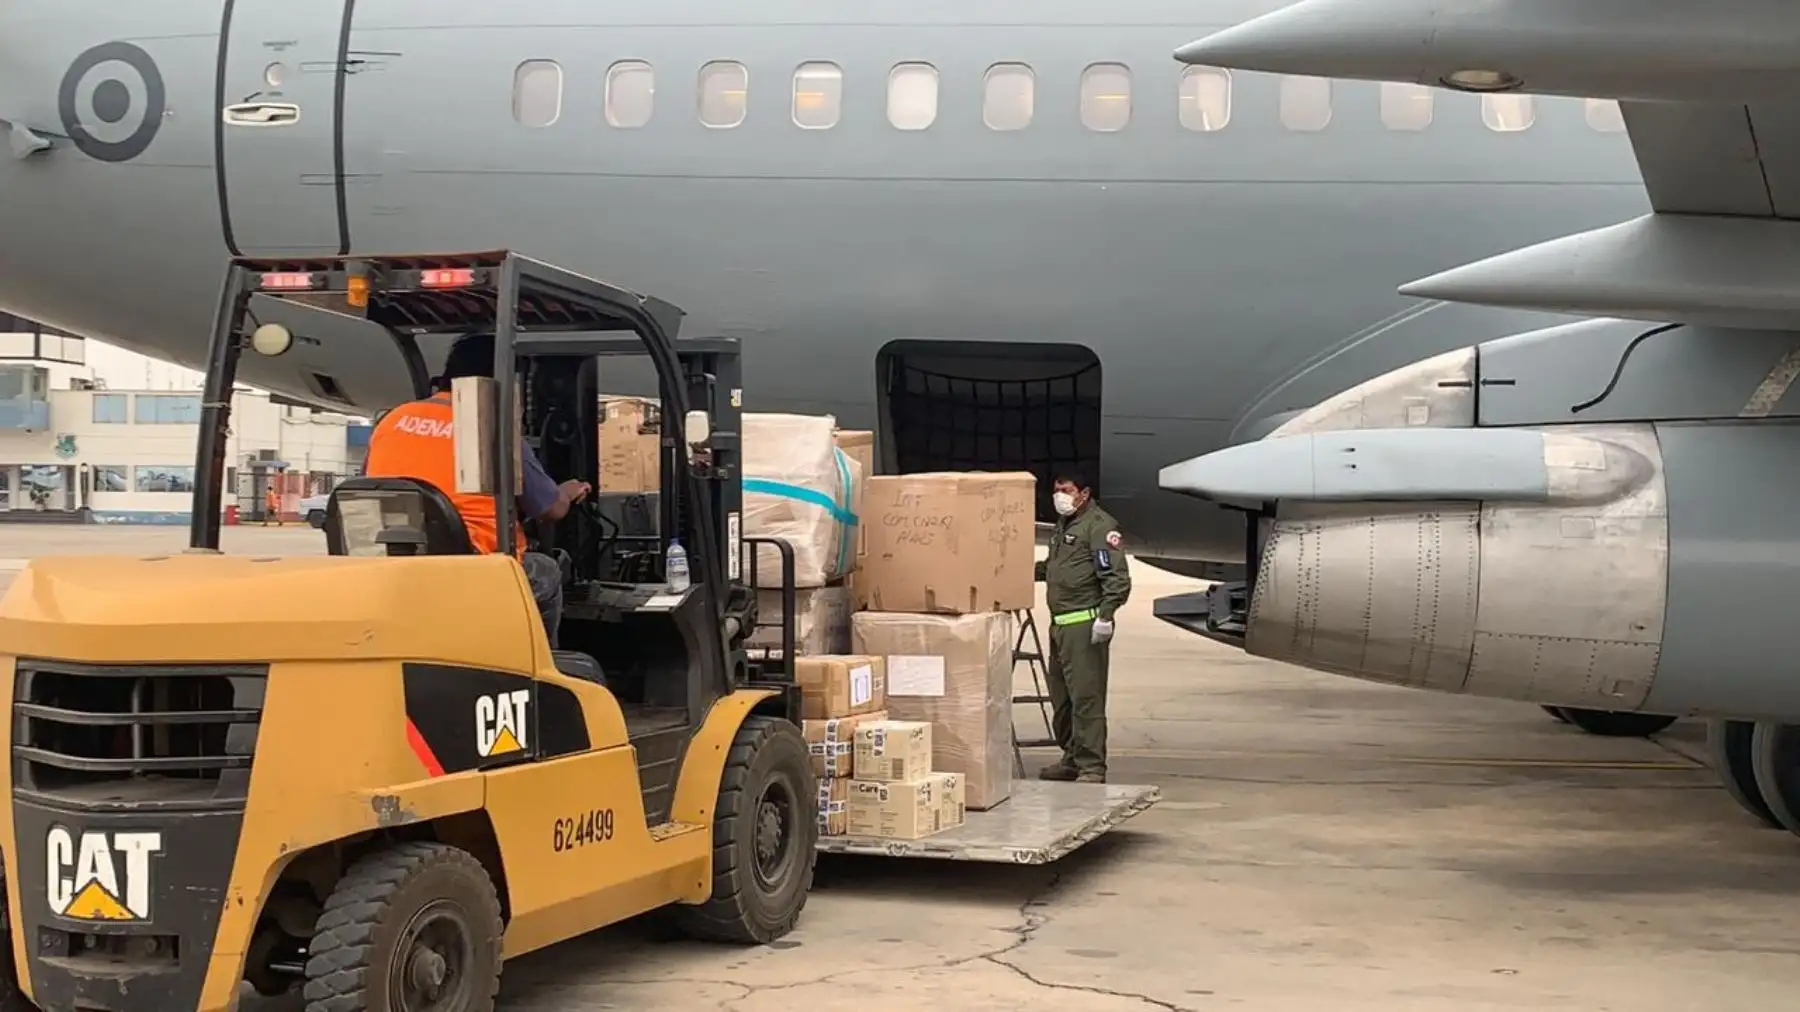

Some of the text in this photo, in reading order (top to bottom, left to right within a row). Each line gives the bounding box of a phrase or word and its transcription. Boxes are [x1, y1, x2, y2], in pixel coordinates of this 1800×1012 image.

[475, 689, 530, 758] CAT
[553, 808, 614, 853] 624499
[47, 828, 161, 919] CAT
